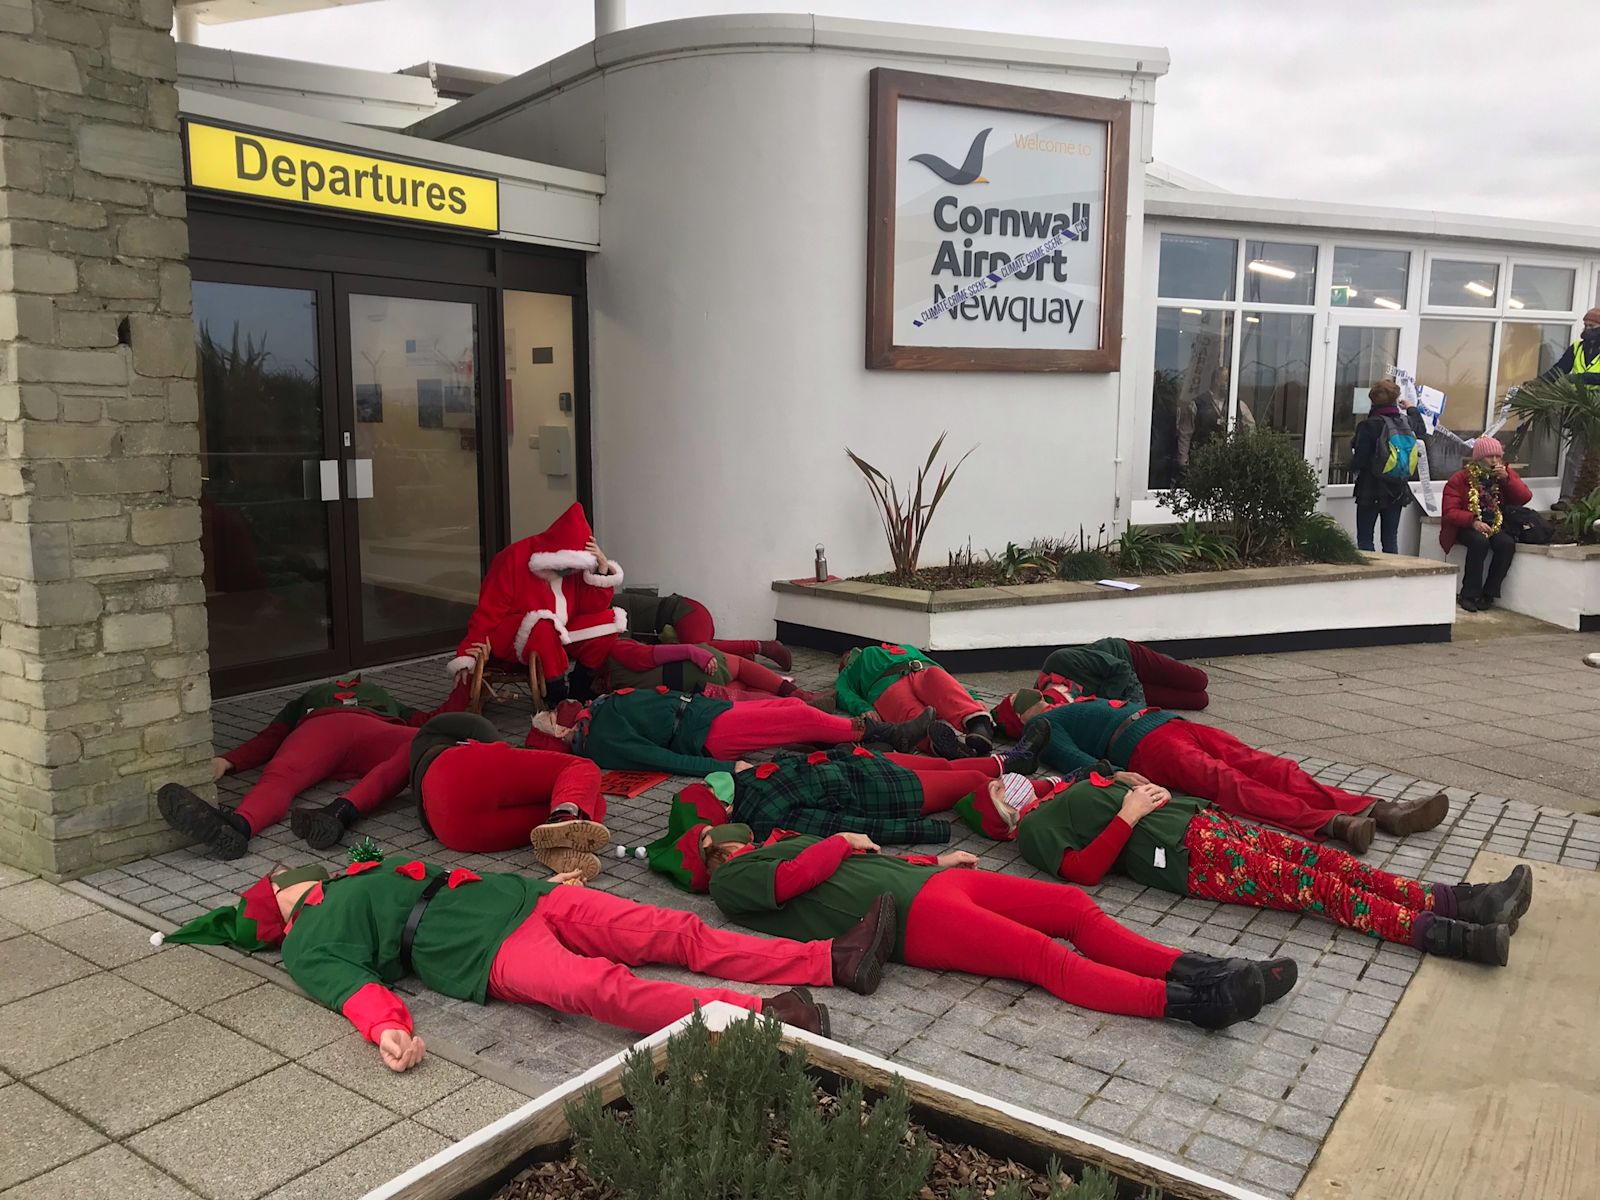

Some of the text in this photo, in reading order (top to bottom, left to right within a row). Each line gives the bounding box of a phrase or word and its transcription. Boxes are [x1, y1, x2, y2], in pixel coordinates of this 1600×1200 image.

[1014, 132, 1091, 156] Welcome to
[234, 136, 467, 214] Departures
[933, 196, 1090, 241] Cornwall
[1000, 235, 1063, 278] CLIMATE CRIME SCENE
[920, 278, 988, 322] CLIMATE CRIME SCENE
